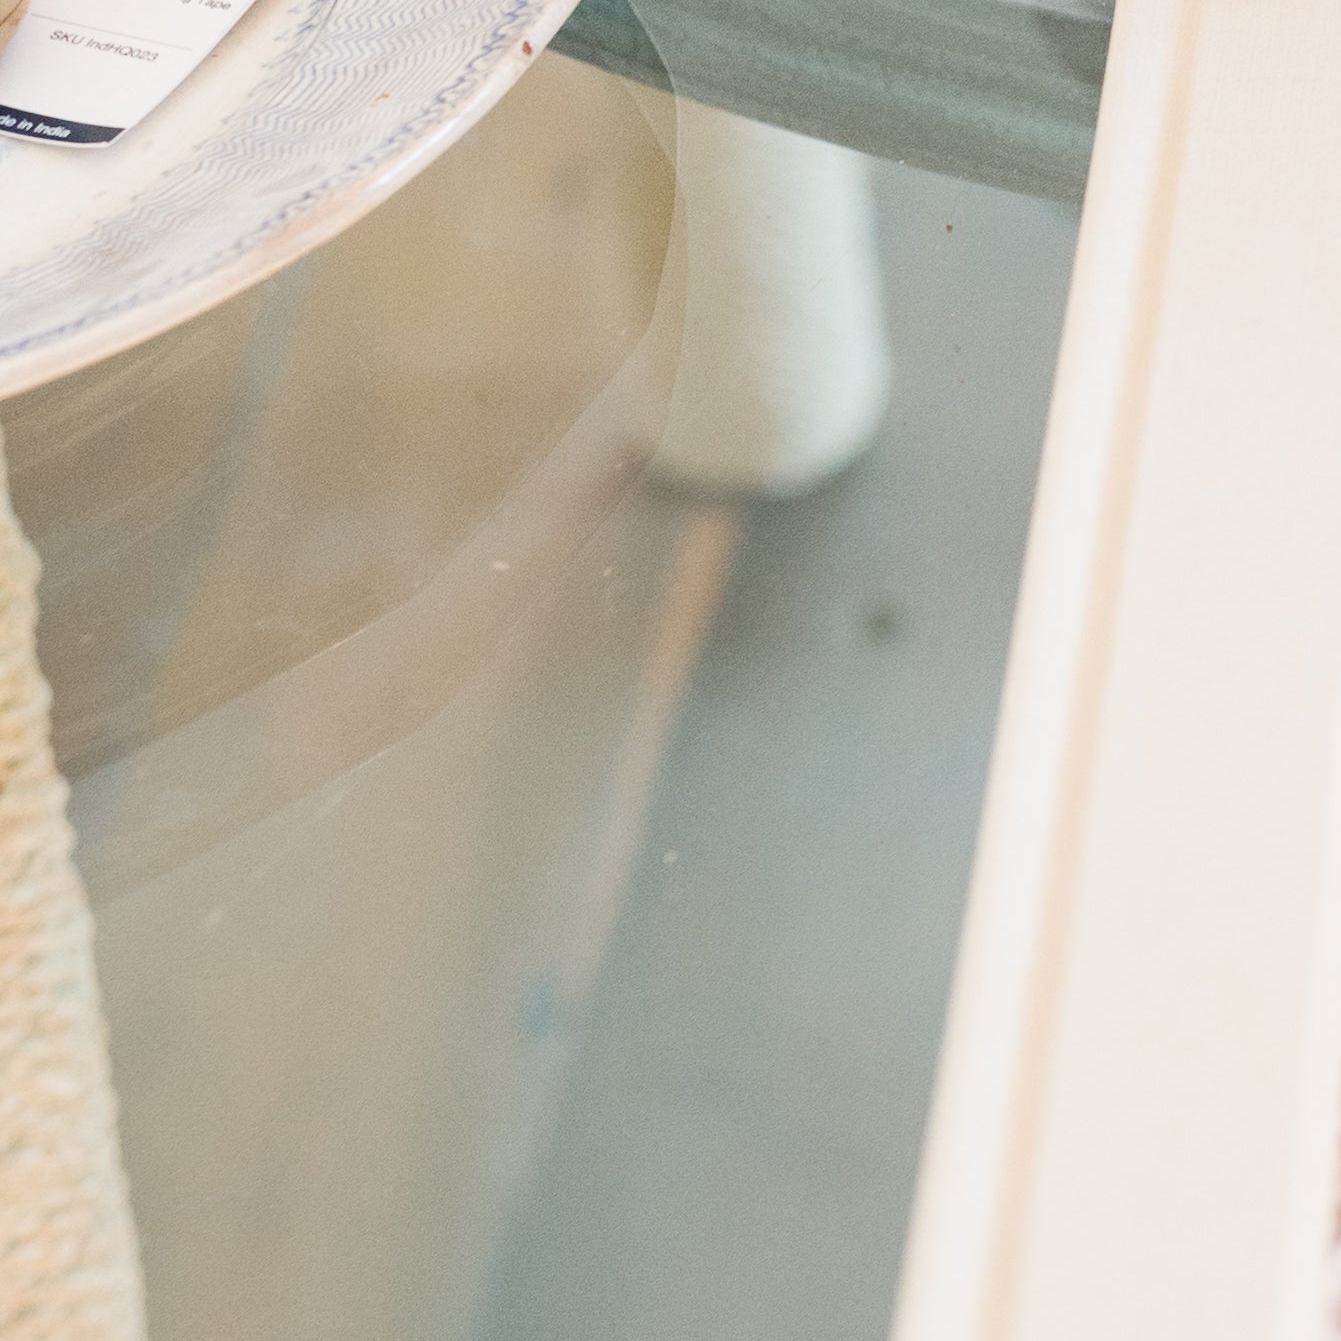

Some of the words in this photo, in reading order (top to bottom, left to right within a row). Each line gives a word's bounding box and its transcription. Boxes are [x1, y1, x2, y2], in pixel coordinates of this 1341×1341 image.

[50, 30, 85, 45] SKU
[16, 118, 33, 131] in
[34, 122, 71, 138] India
